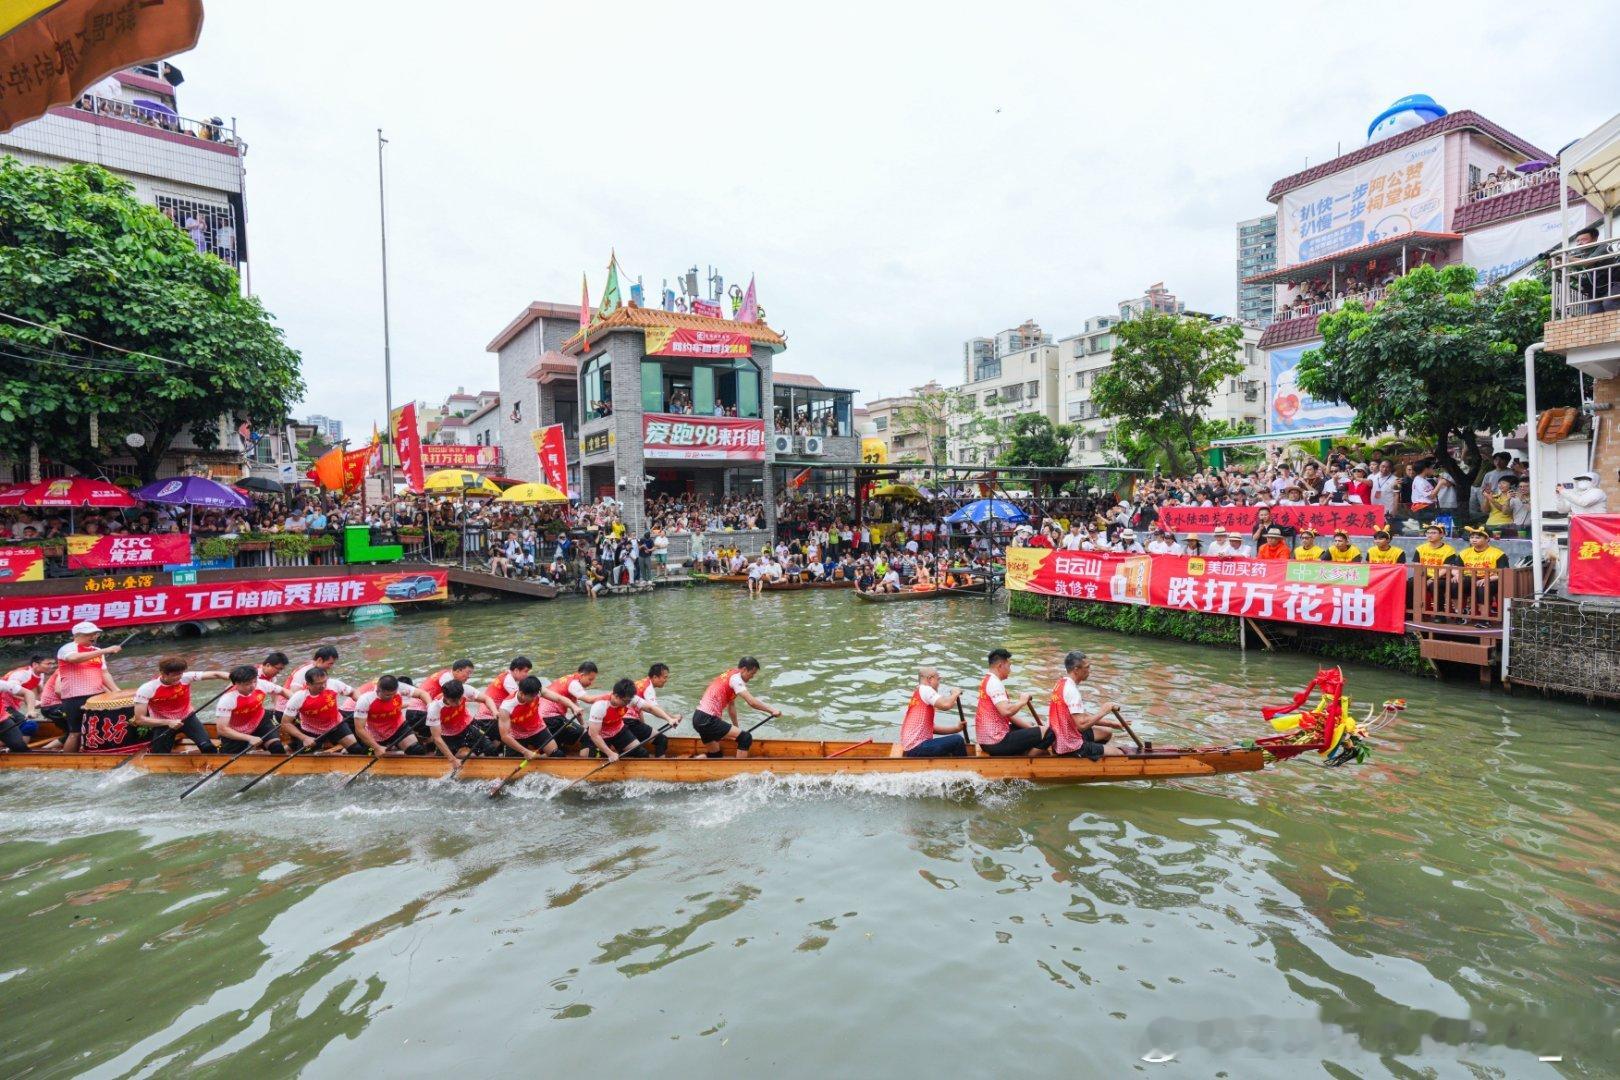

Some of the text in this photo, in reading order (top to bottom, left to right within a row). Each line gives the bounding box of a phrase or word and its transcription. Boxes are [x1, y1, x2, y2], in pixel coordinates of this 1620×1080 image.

[112, 537, 152, 548] KFC
[1055, 557, 1102, 577] 白云山
[1208, 561, 1268, 578] 美团买药
[1055, 580, 1098, 599] 敬修堂
[1167, 577, 1375, 627] 跌打万花油
